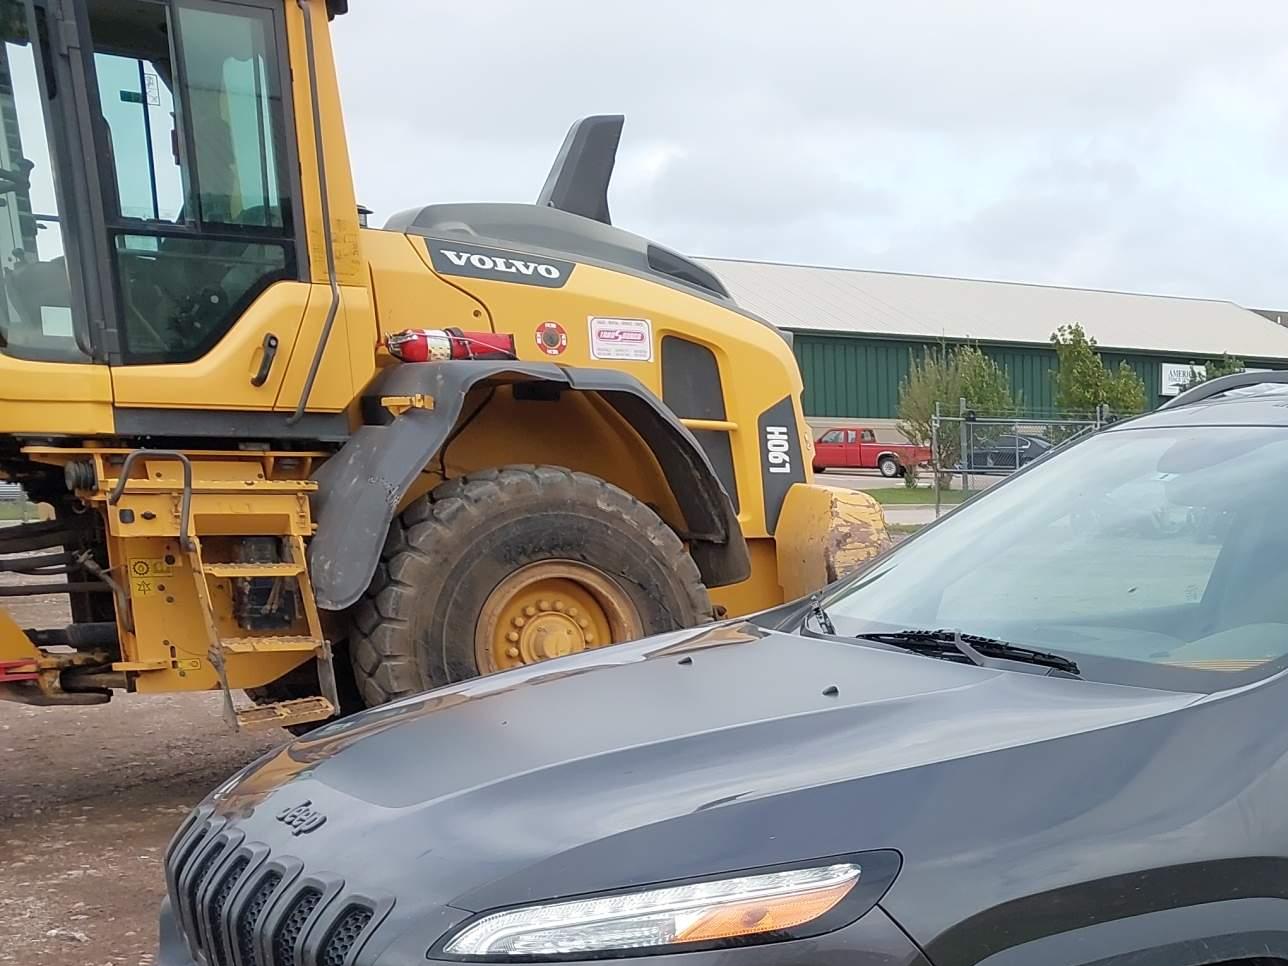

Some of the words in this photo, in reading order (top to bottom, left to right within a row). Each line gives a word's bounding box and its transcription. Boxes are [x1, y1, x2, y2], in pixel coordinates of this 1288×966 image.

[440, 249, 561, 279] VOLVO
[766, 426, 791, 473] L90H
[275, 799, 328, 837] Jeep
